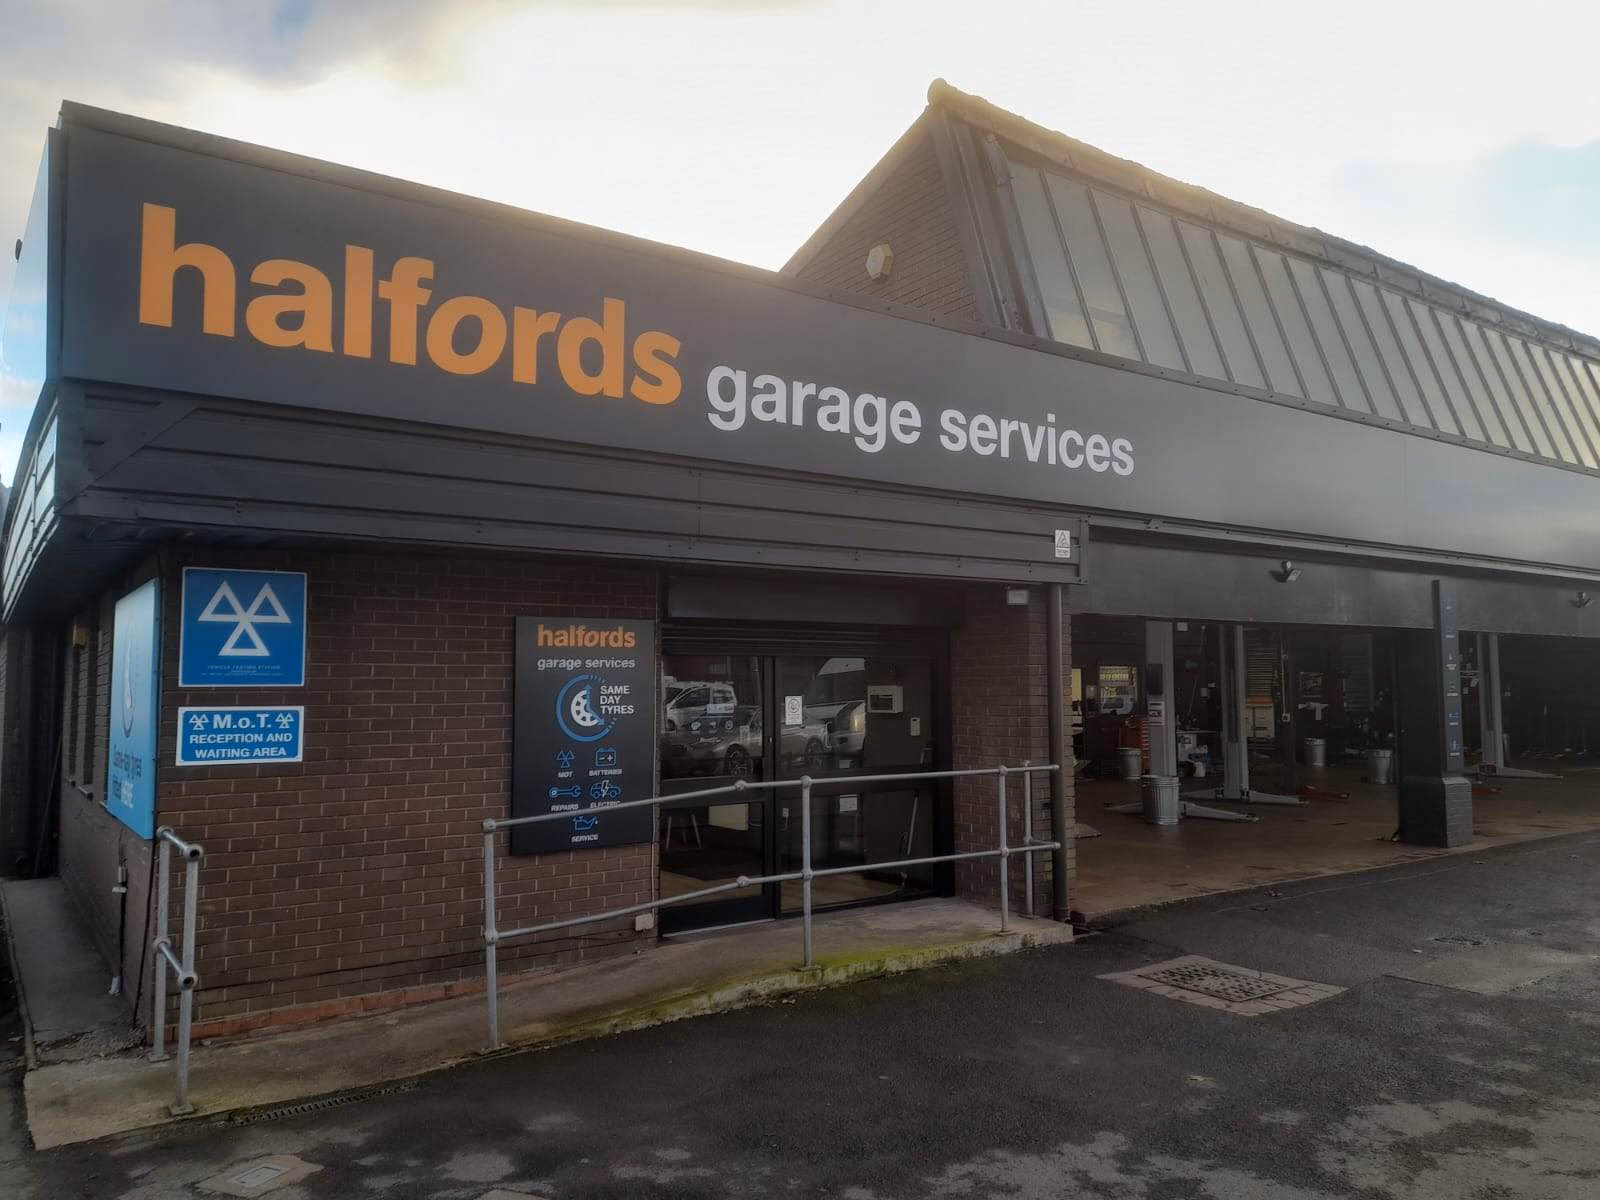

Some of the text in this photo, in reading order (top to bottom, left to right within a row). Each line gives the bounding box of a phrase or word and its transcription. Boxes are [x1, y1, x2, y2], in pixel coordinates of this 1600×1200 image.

[139, 202, 682, 404] halfords
[706, 365, 1135, 476] garage services
[537, 623, 636, 648] halfords
[537, 657, 636, 671] garage services
[600, 685, 630, 695] SAME
[600, 695, 621, 705] DAY
[600, 705, 635, 715] TYRES
[213, 713, 272, 729] M.o.T.
[189, 732, 293, 744] RECEPTION AND
[195, 747, 287, 759] WAITING AREA
[551, 804, 579, 812] REPAIRS
[571, 834, 599, 843] SERVICE
